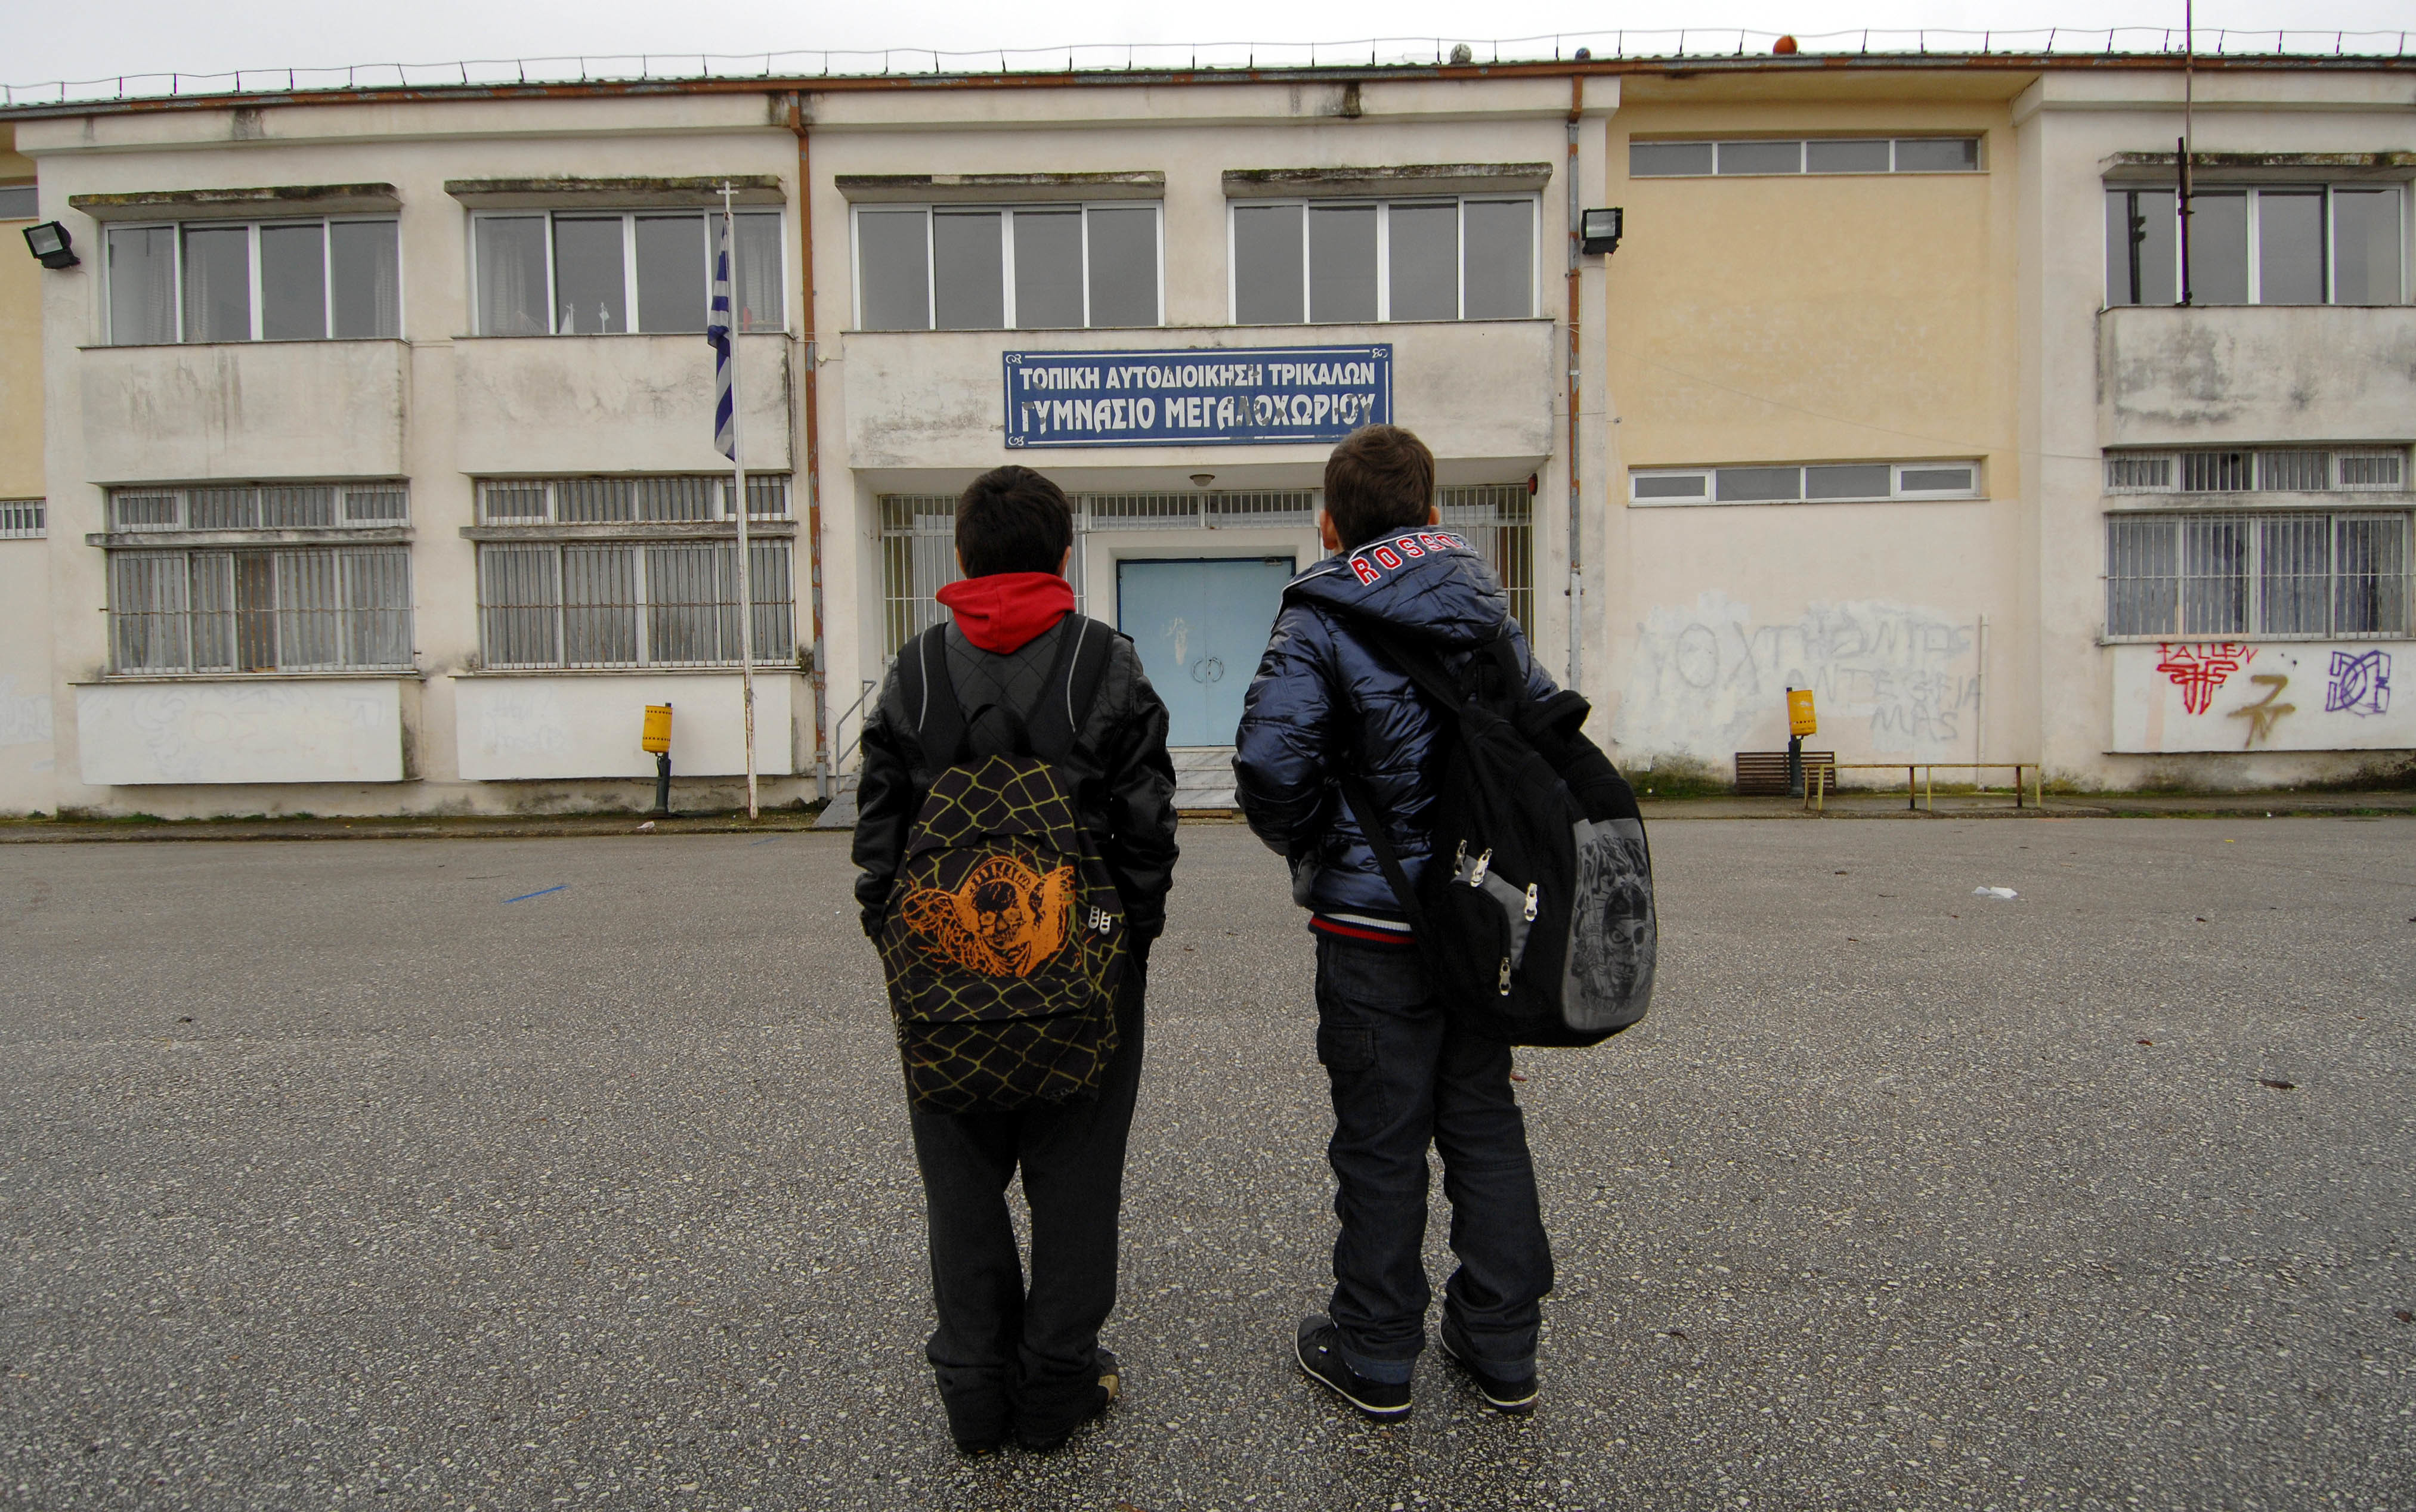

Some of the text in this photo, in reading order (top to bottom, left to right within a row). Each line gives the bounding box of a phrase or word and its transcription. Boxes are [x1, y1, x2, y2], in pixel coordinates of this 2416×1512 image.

[1019, 362, 1375, 390] ΤΟΠΙΚΗ ΑΥΤΟΔΙΟΙΚΗΣΗ ΤΡΙΚΑΛΩΝ
[1022, 394, 1375, 434] ΓΥΜΝΑΣΙΟ ΜΕΓΑΛΟΧΩΡΙΟΥ
[2156, 642, 2259, 664] FALLEN
